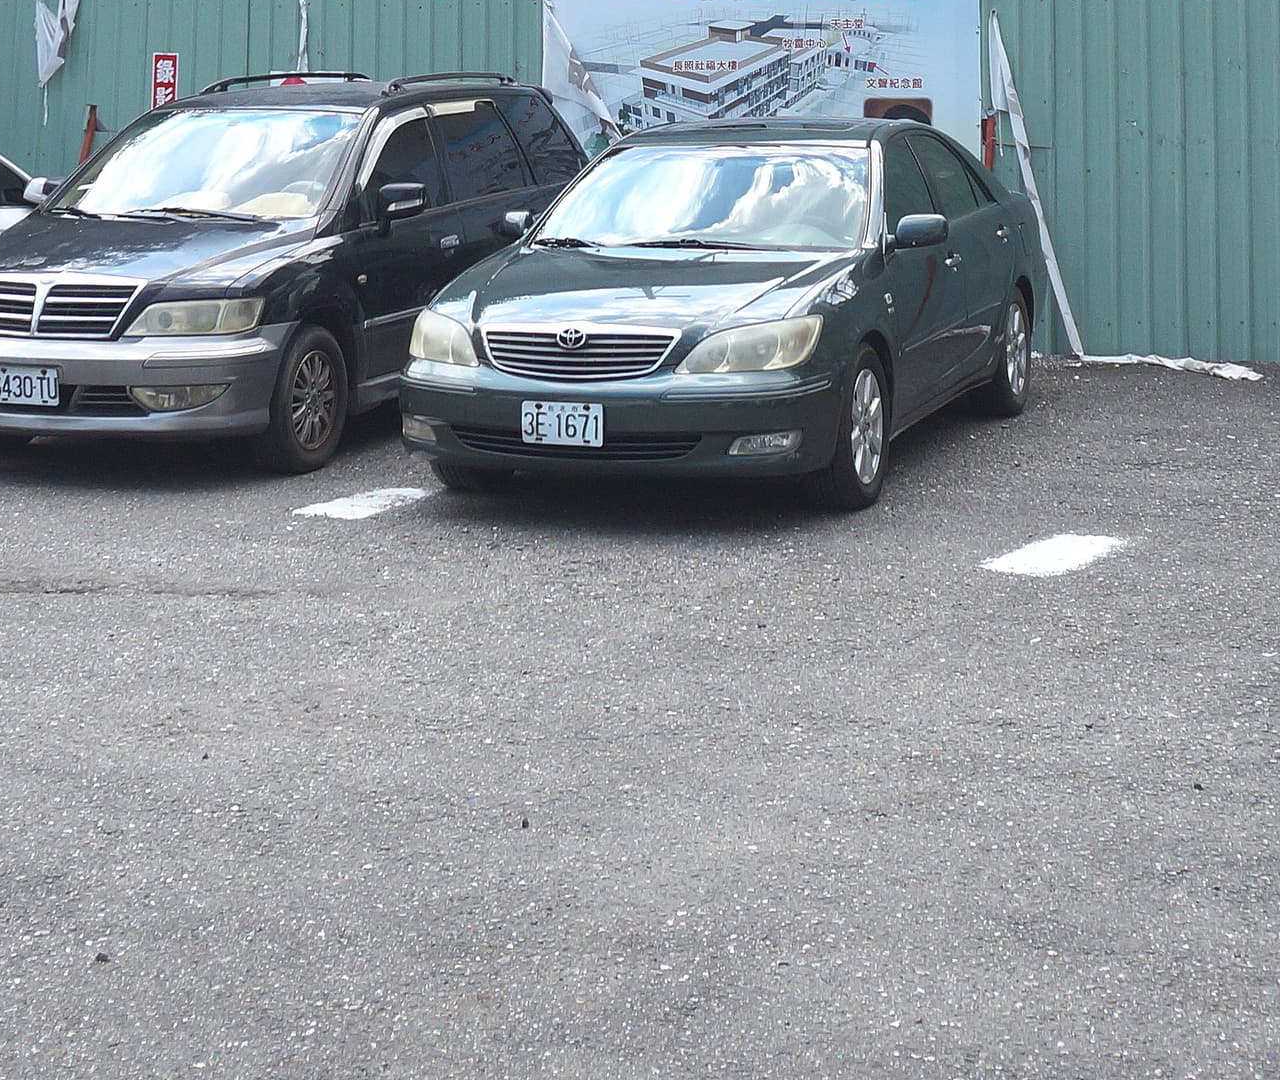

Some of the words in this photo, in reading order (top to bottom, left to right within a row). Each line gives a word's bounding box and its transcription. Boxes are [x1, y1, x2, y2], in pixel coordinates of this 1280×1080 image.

[831, 18, 865, 30] 天主堂
[523, 412, 599, 441] 3E-1671
